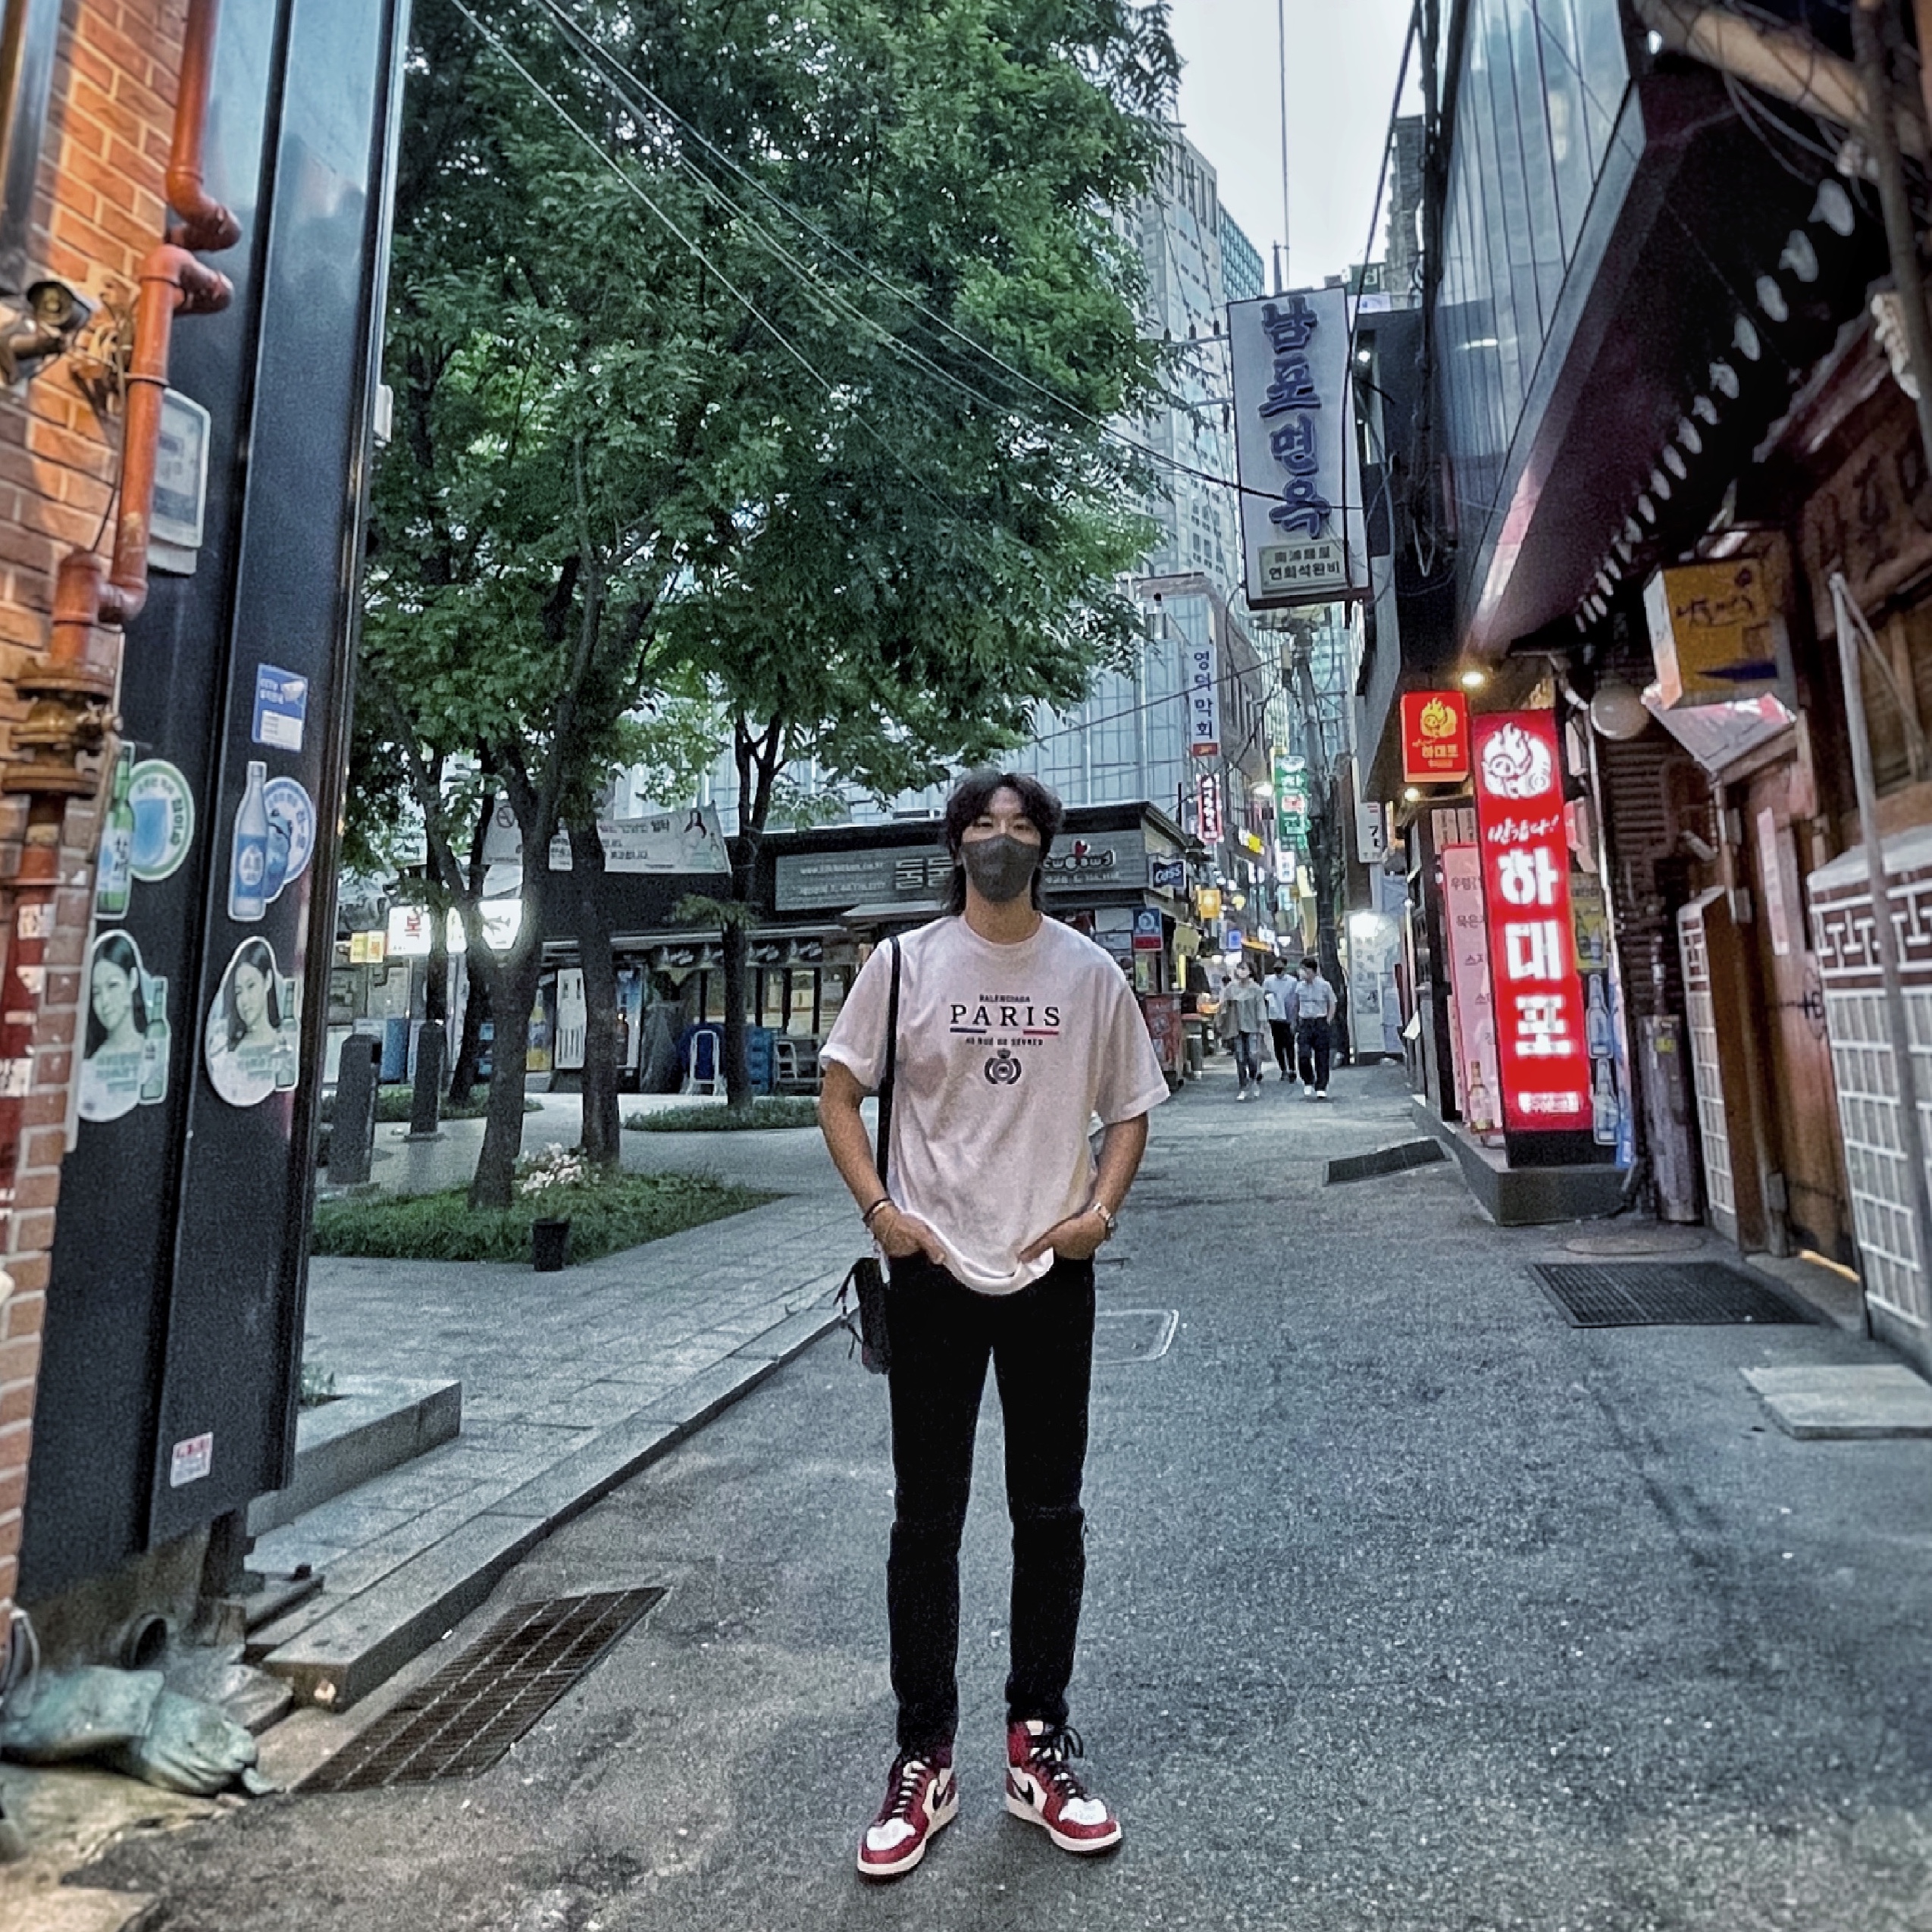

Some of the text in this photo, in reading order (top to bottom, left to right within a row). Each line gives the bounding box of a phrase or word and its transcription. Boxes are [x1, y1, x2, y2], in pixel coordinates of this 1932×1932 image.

[1258, 296, 1332, 540] 남포면옥
[950, 1004, 1061, 1026] PARIS
[1498, 847, 1574, 1058] 하대포
